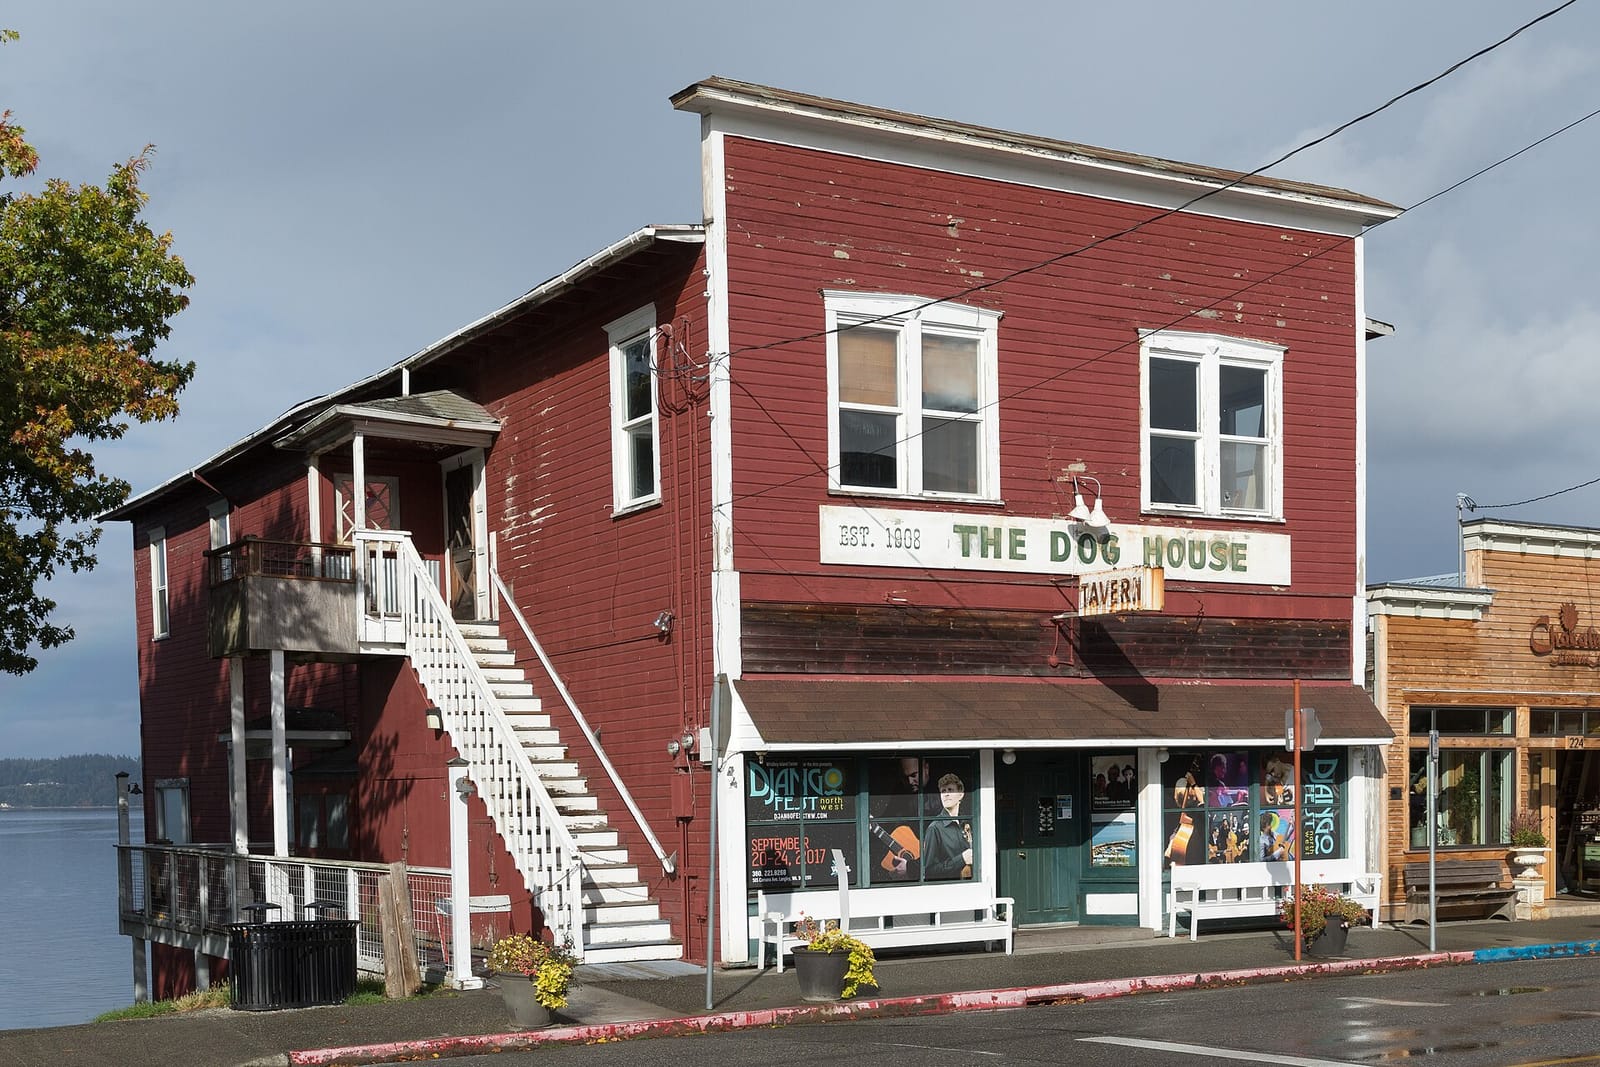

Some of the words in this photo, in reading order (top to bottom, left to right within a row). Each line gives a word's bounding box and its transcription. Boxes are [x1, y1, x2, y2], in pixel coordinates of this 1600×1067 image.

[839, 525, 874, 547] EST.
[886, 527, 921, 550] 1908
[953, 524, 1027, 560] THE
[1050, 530, 1121, 565] DOG
[1143, 536, 1248, 572] HOUSE
[1080, 576, 1142, 607] TAVERN
[1569, 737, 1584, 748] 224
[749, 761, 843, 805] DJANGO
[774, 796, 818, 811] FEST
[1304, 784, 1315, 828] FEST
[1308, 759, 1338, 854] DJANGO
[752, 837, 810, 851] SEPTEMBER
[752, 850, 791, 867] 20-24,
[795, 849, 826, 865] 2017
